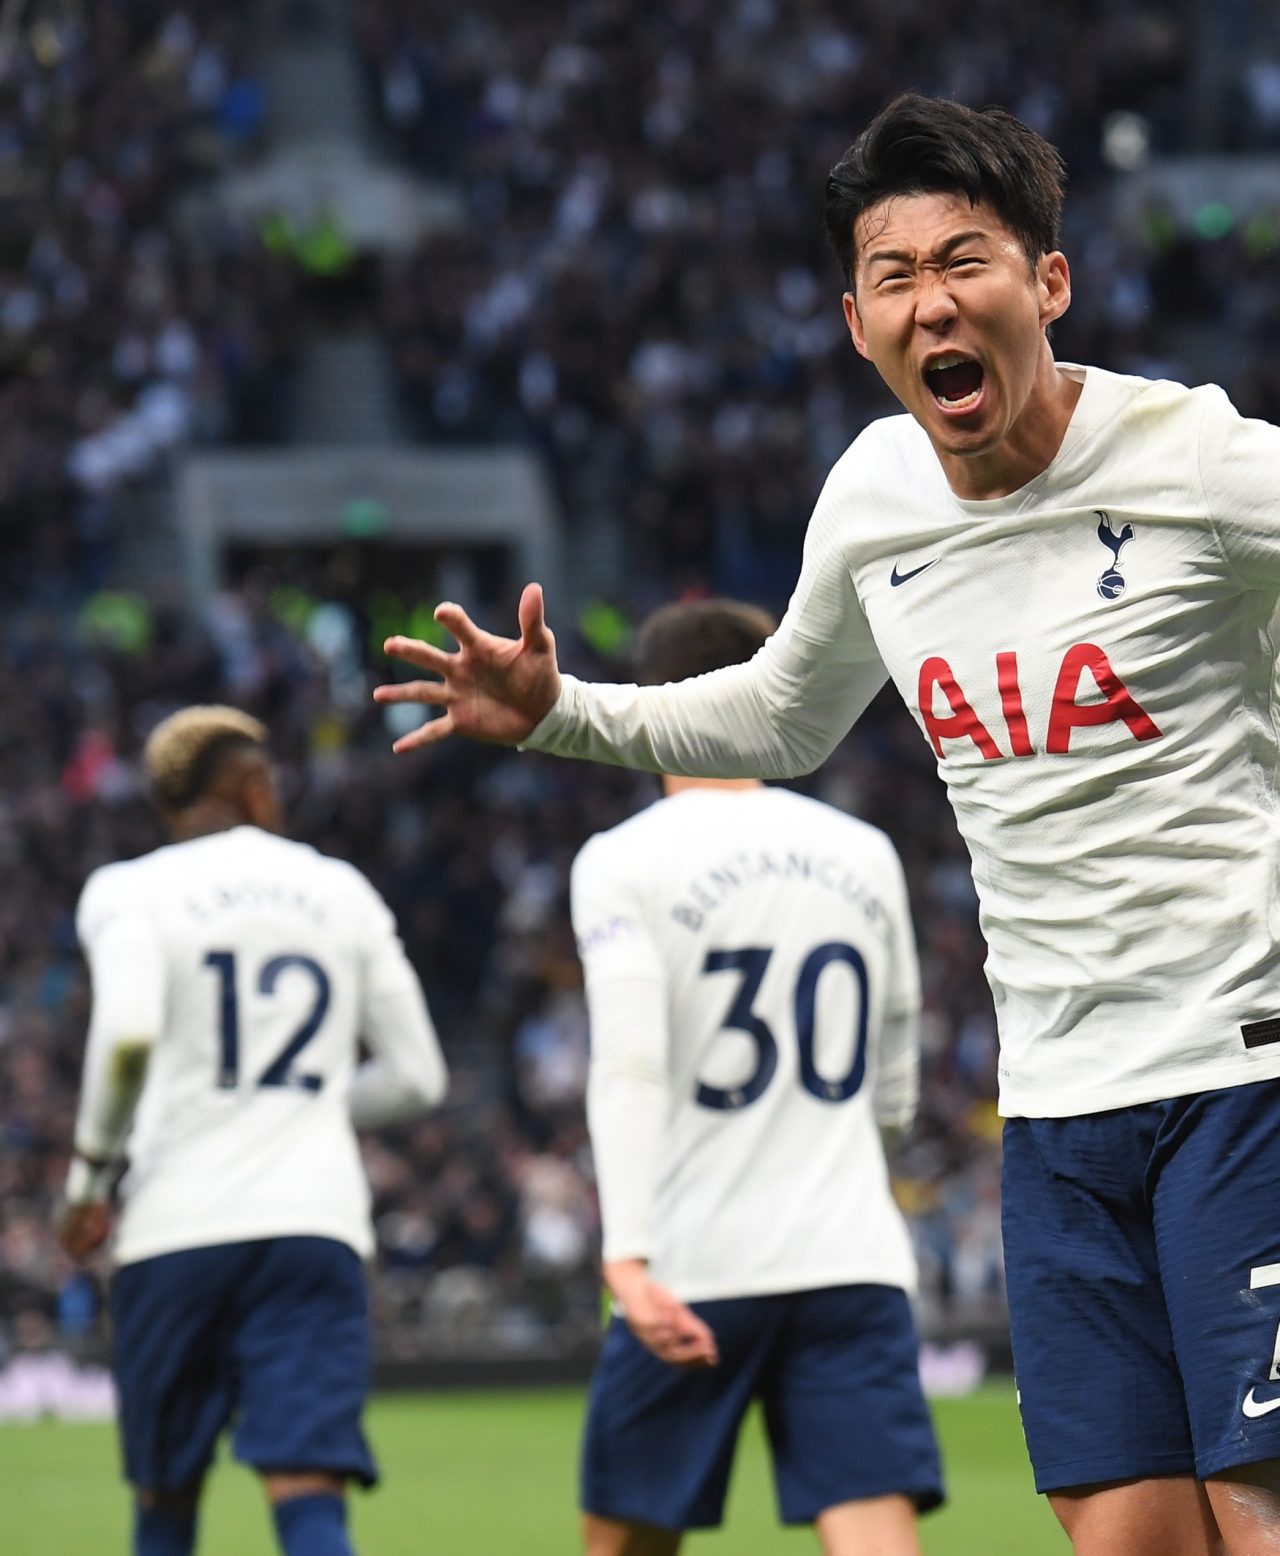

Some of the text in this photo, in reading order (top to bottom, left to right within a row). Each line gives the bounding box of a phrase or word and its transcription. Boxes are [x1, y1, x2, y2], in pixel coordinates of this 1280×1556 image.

[918, 642, 1163, 760] AIA
[203, 951, 332, 1096] 12
[694, 941, 870, 1113] 30
